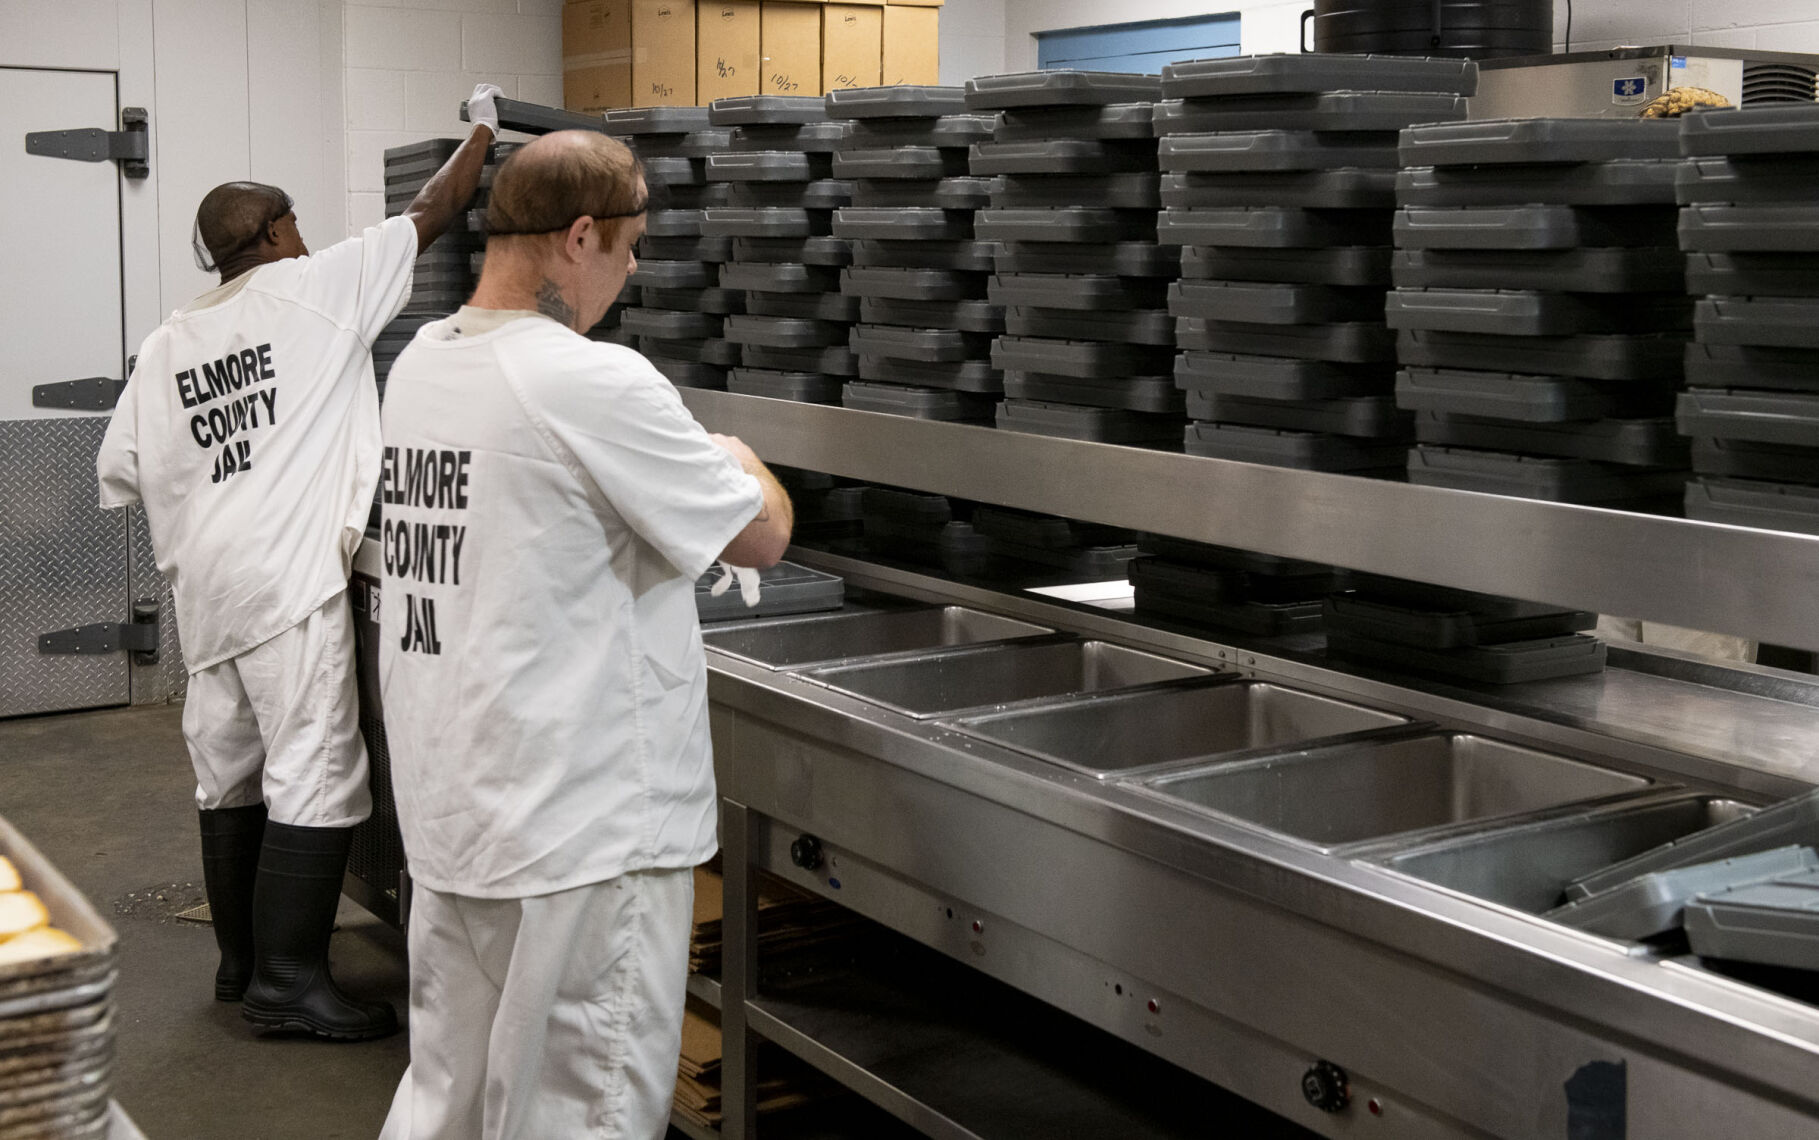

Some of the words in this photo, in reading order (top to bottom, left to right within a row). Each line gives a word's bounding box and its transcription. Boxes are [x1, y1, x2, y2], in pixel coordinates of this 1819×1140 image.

[652, 82, 673, 98] 10/27
[770, 73, 798, 91] 10/27
[835, 75, 857, 87] 10/
[175, 343, 275, 409] ELMORE
[190, 387, 277, 448] COUNTY
[211, 440, 252, 484] JAIL
[384, 446, 472, 509] ELMORE
[384, 518, 466, 585] COUNTY
[401, 593, 441, 655] JAIL
